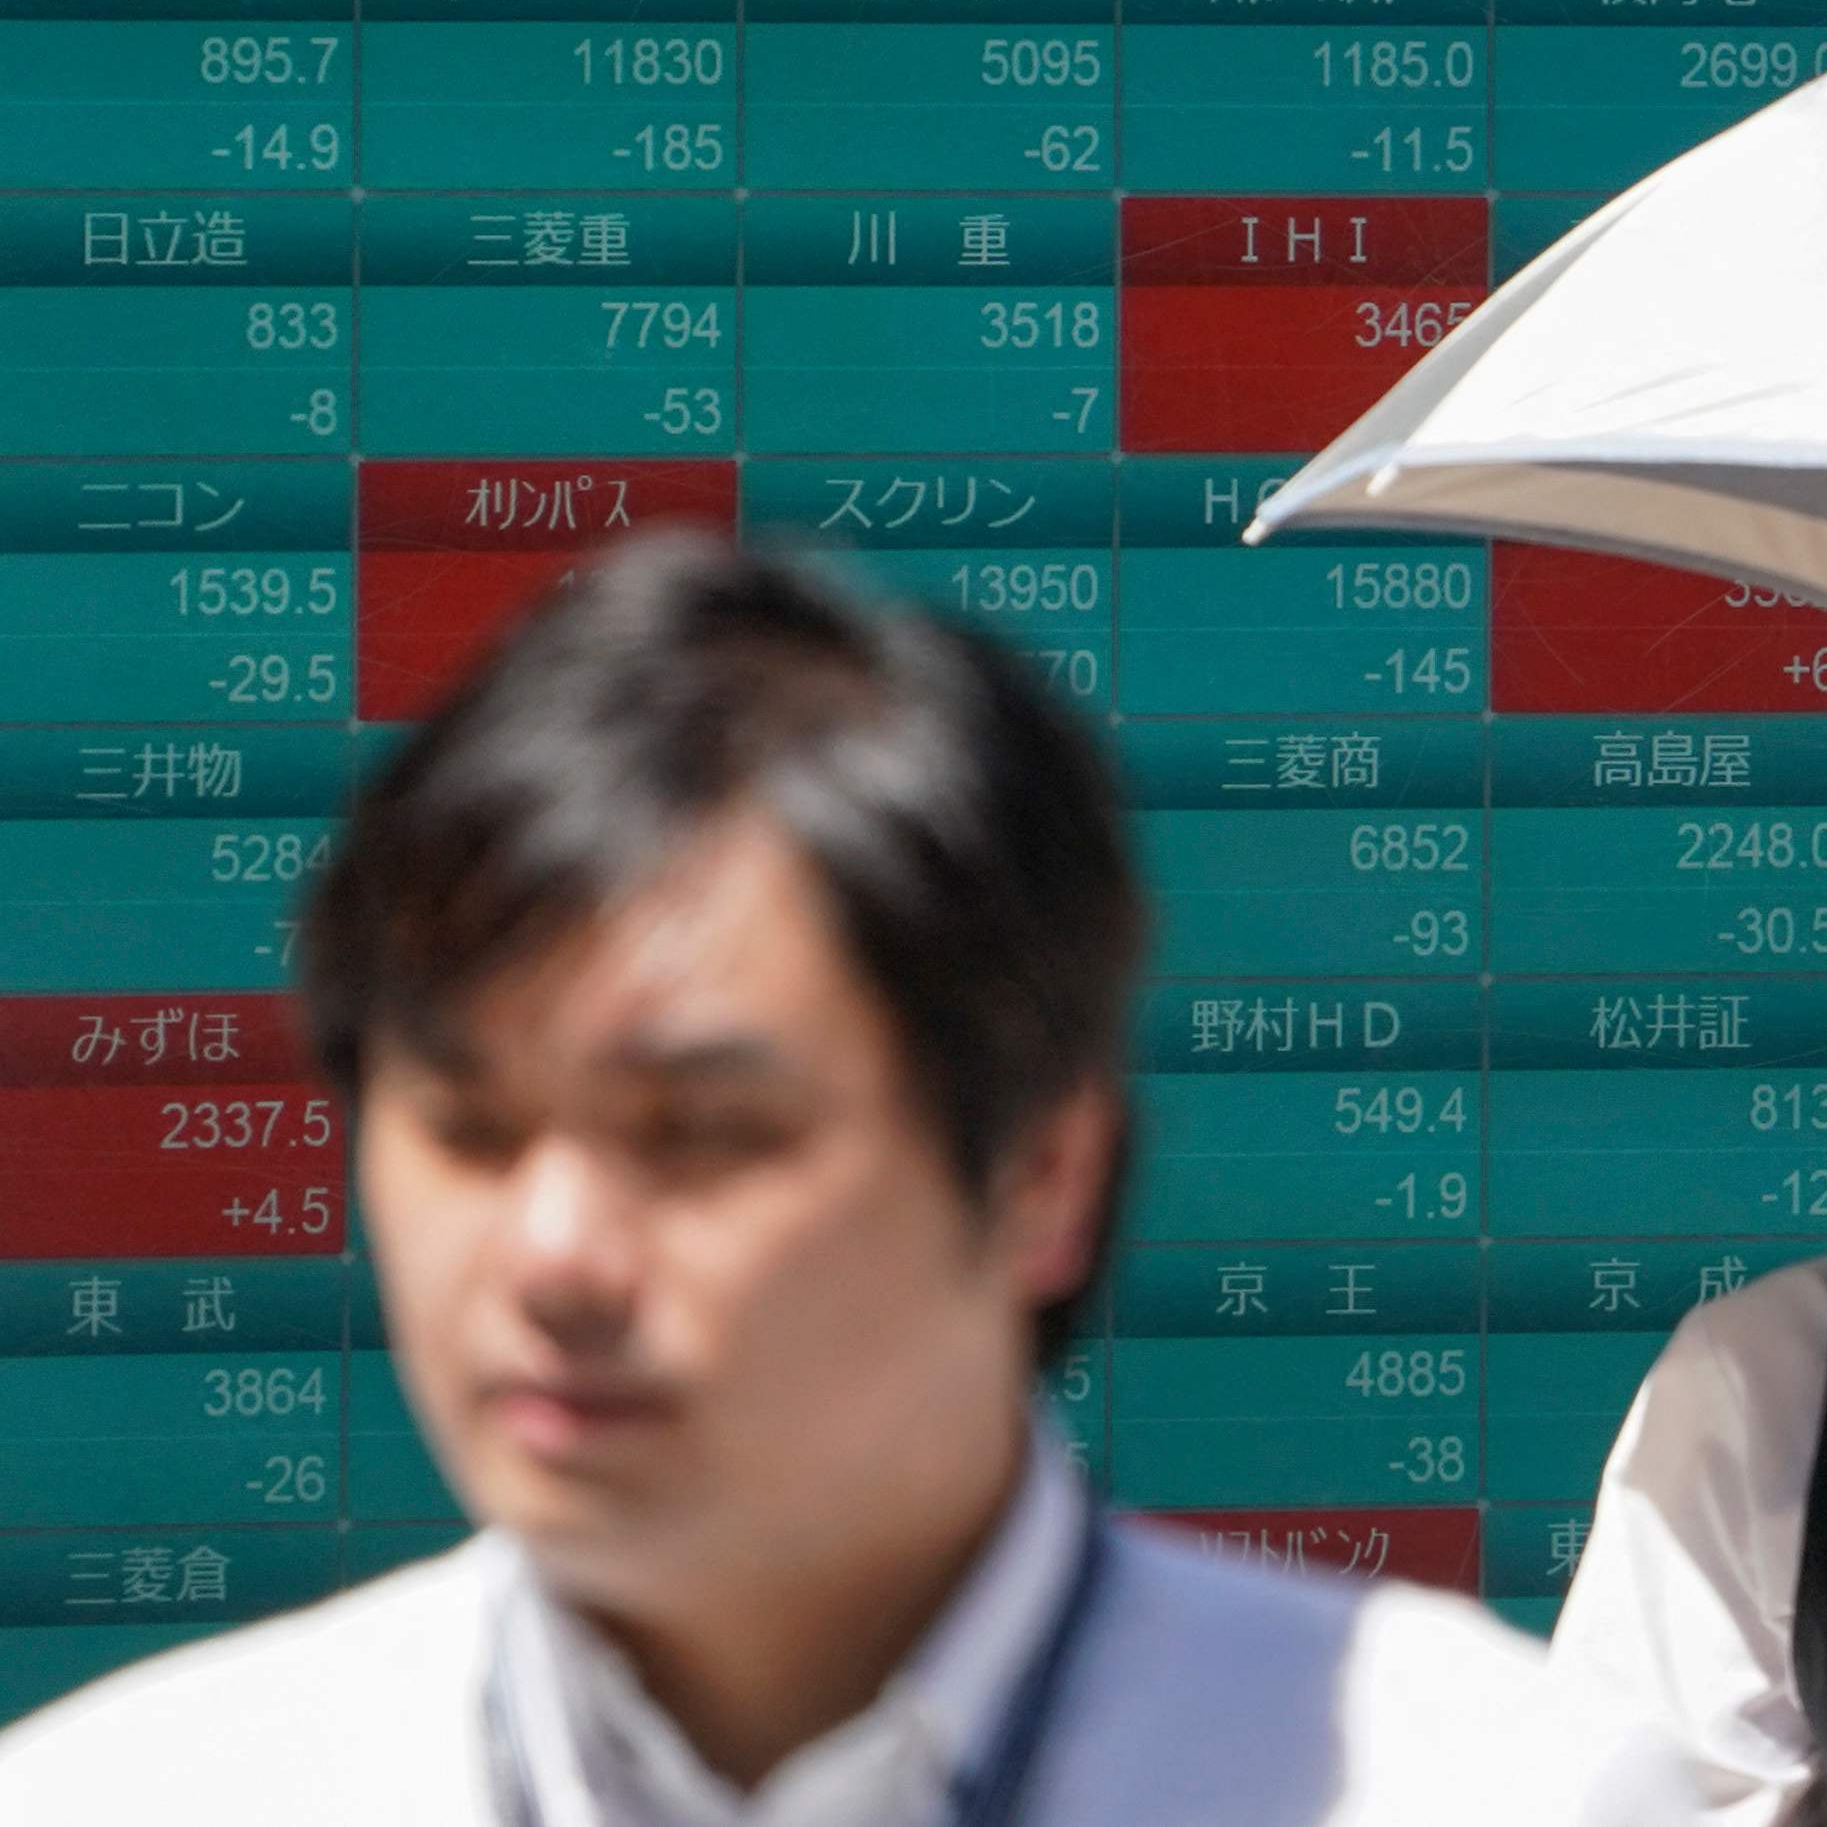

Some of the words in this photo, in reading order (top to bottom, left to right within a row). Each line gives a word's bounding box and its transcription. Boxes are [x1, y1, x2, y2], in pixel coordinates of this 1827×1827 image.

[574, 38, 722, 85] 11830
[982, 39, 1100, 86] 5095
[84, 211, 247, 266] 日立造
[467, 211, 631, 266] 三菱重
[980, 301, 1100, 349] 3518
[79, 483, 244, 531] ニコン
[819, 476, 1036, 528] スクリン
[170, 567, 337, 617] 1539.5
[1326, 562, 1472, 610] 15880
[76, 742, 241, 800] 三井物
[1222, 731, 1380, 789] 三菱商
[1594, 729, 1750, 787] 高島屋
[1350, 824, 1469, 872] 6852
[71, 1007, 239, 1065] みずほ
[1590, 994, 1750, 1050] 松井証
[160, 1099, 331, 1150] 2337.5
[1345, 1349, 1465, 1397] 4885
